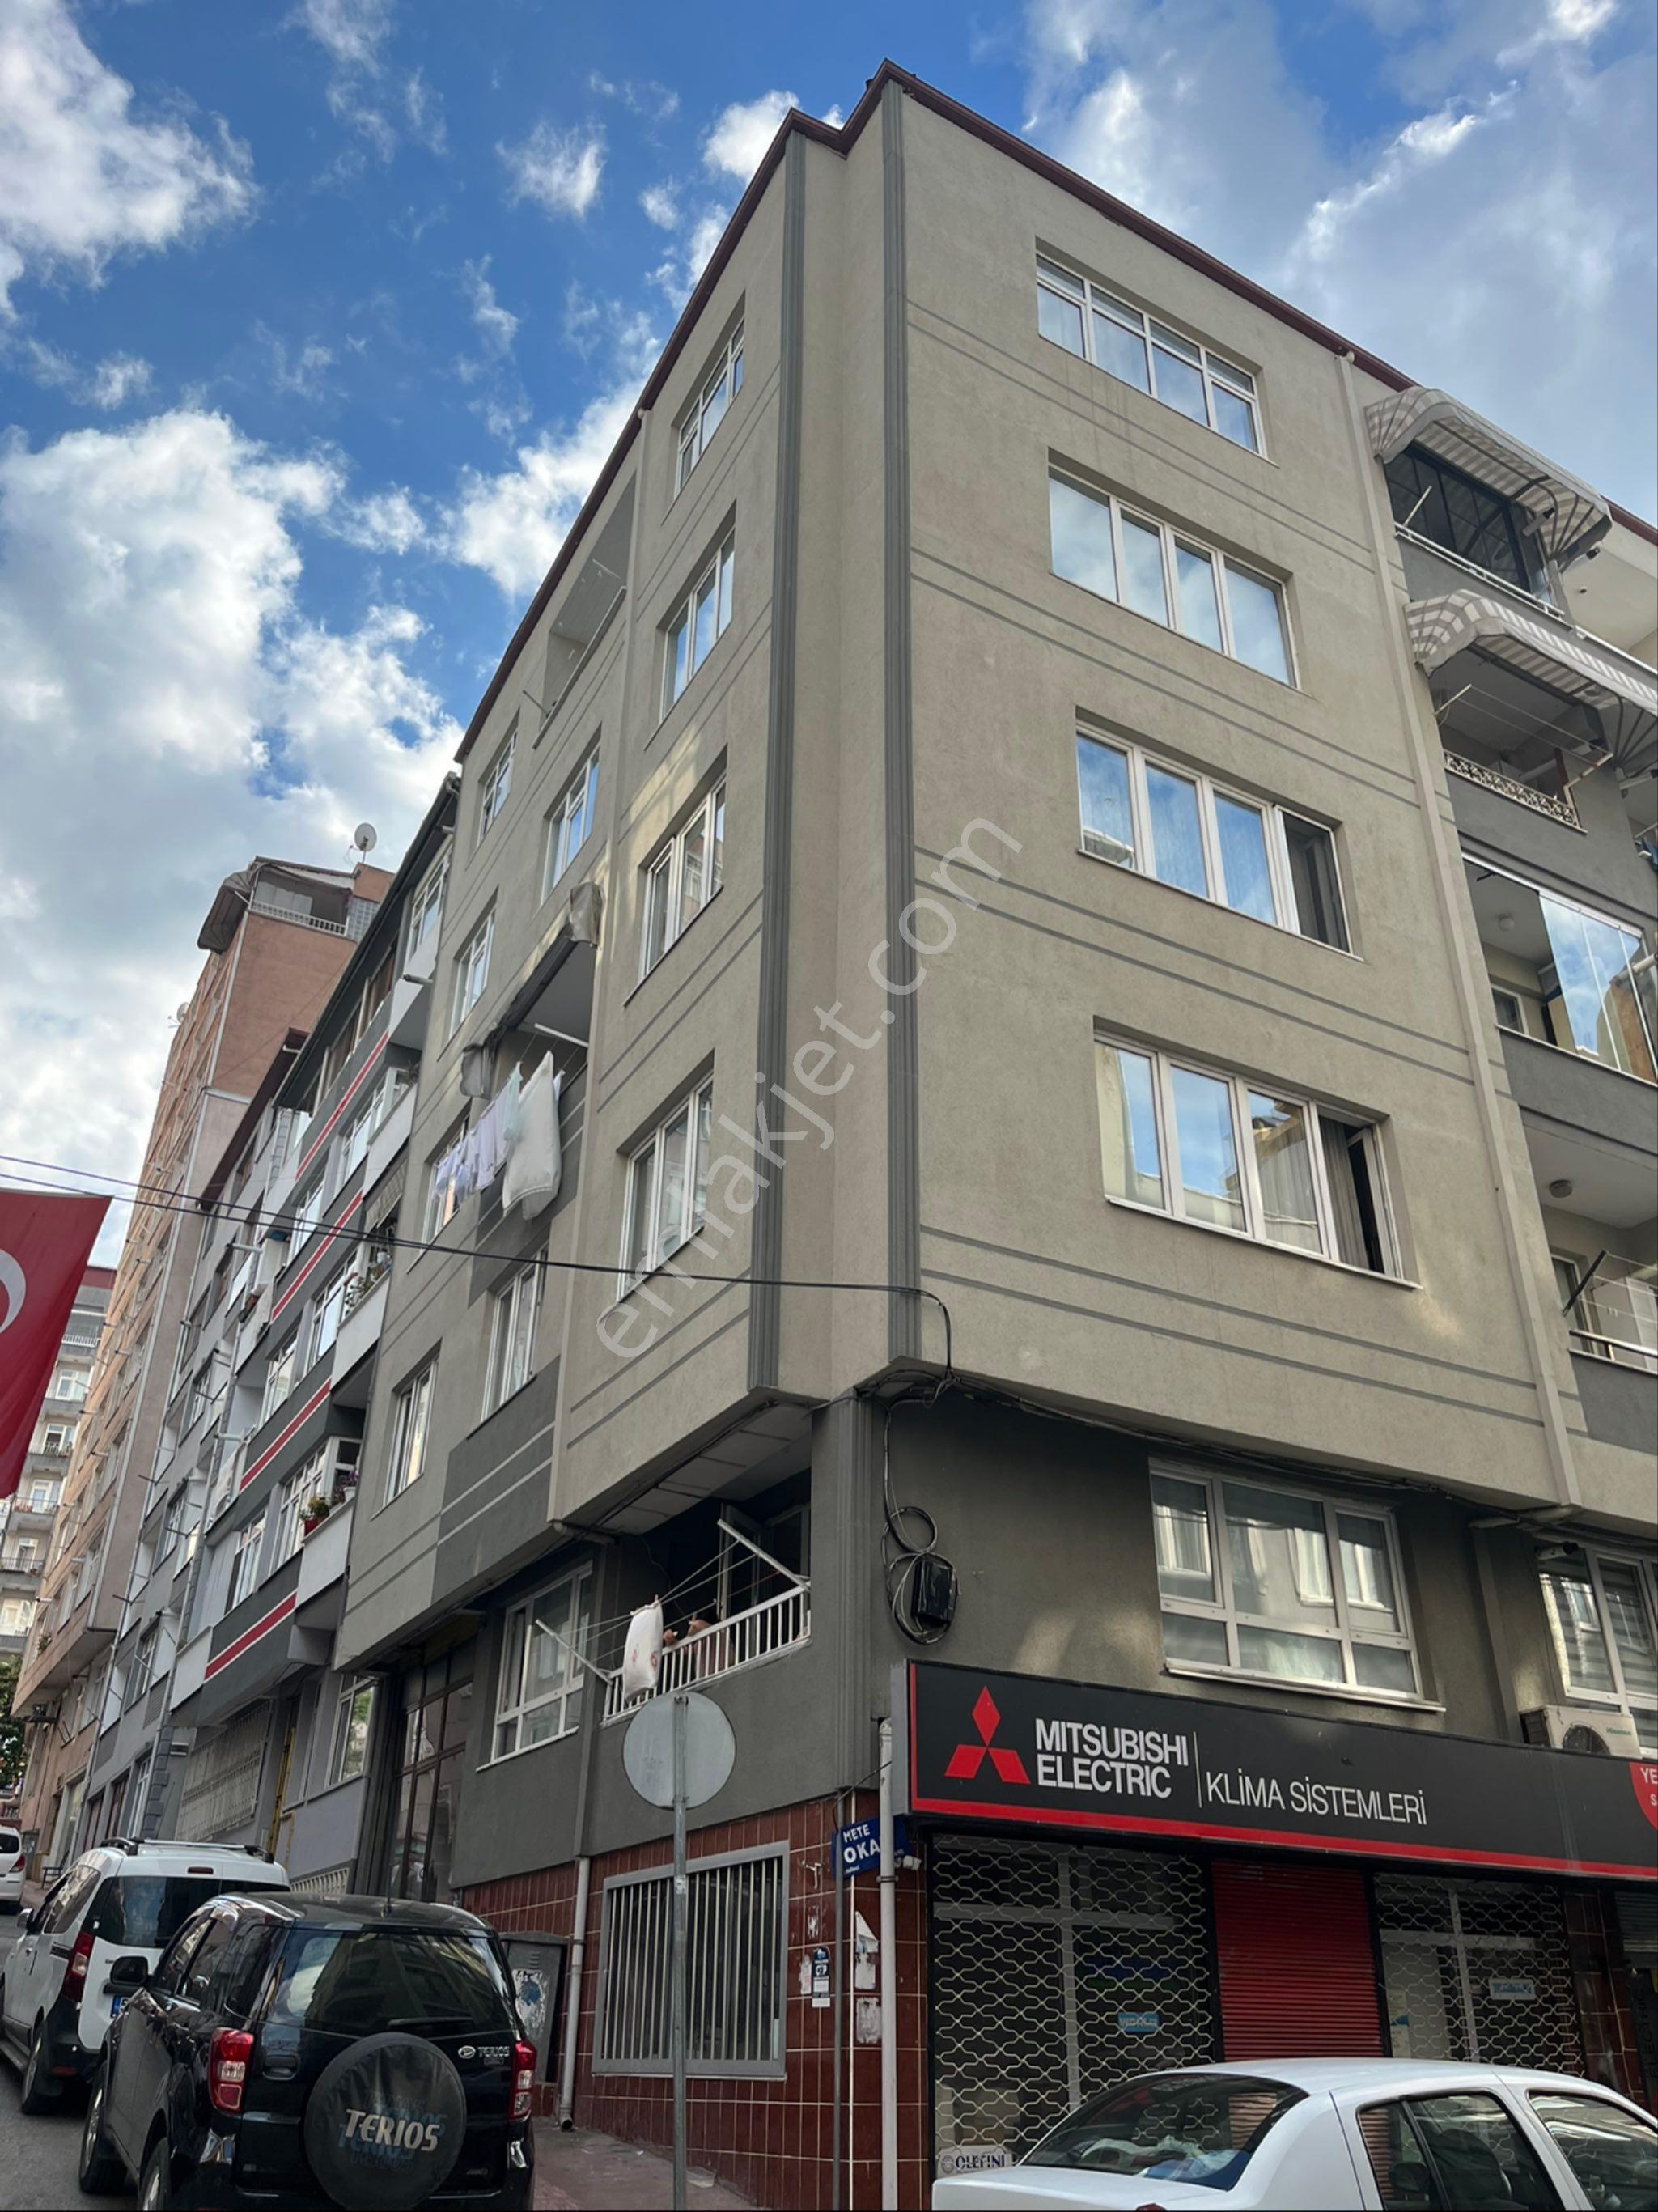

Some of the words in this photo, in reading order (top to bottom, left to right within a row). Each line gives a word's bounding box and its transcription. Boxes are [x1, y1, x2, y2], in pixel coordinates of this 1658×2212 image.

[1035, 1718, 1189, 1766] MITSUBISHI
[1037, 1754, 1172, 1798] ELECTRIC
[1206, 1768, 1285, 1810] KLİMA
[1289, 1776, 1427, 1825] SİSTEMLERİ
[1640, 1767, 1658, 1785] YE
[842, 1824, 871, 1843] METE
[843, 1838, 880, 1863] OKA
[345, 2108, 440, 2151] TERIOS
